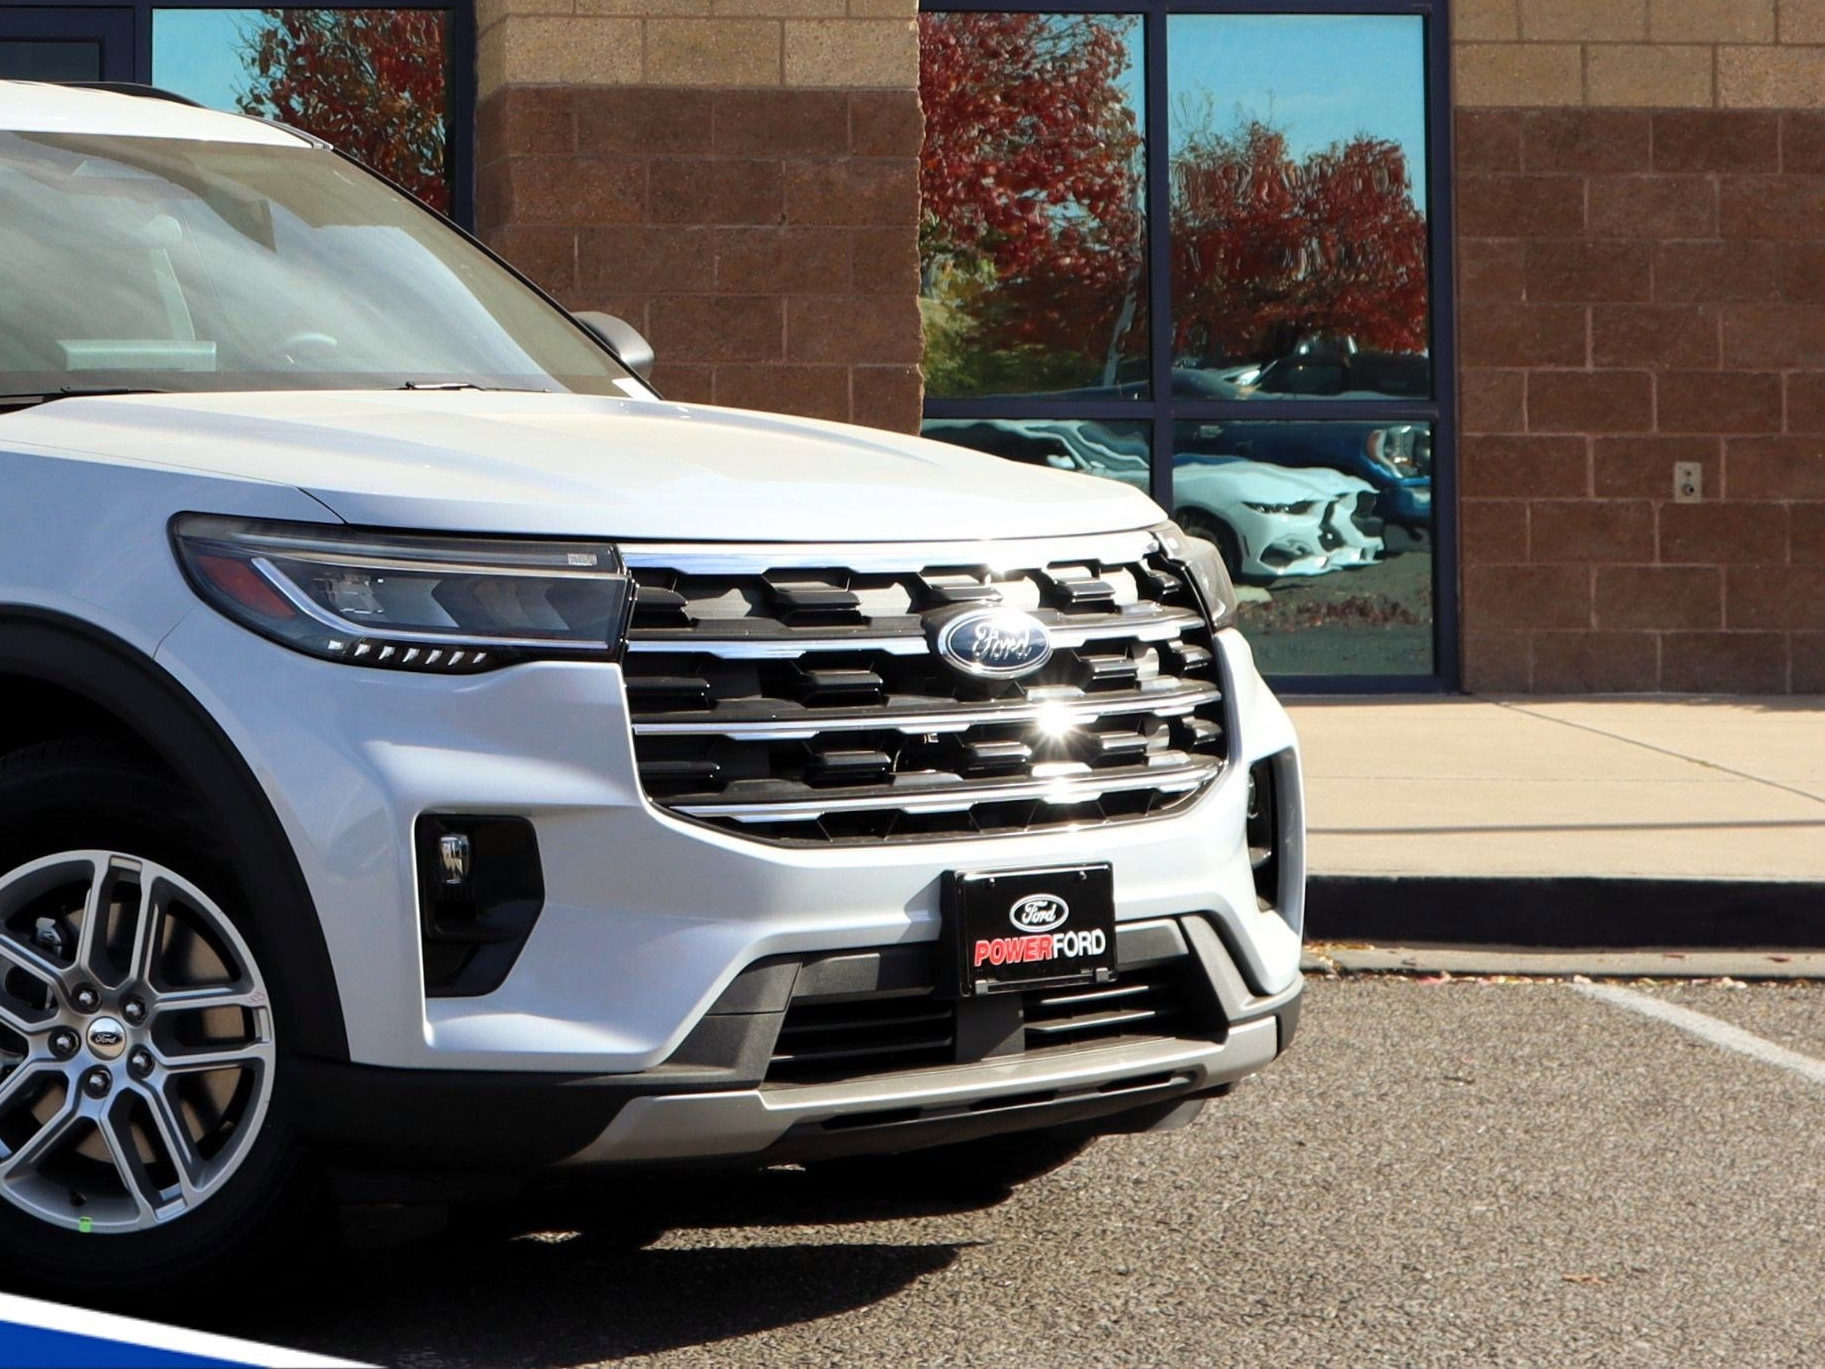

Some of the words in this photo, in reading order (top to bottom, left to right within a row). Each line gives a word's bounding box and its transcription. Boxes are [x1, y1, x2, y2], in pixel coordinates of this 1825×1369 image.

[973, 623, 1031, 660] Ford
[1021, 900, 1056, 924] Ford
[974, 929, 1106, 967] POWERFORD
